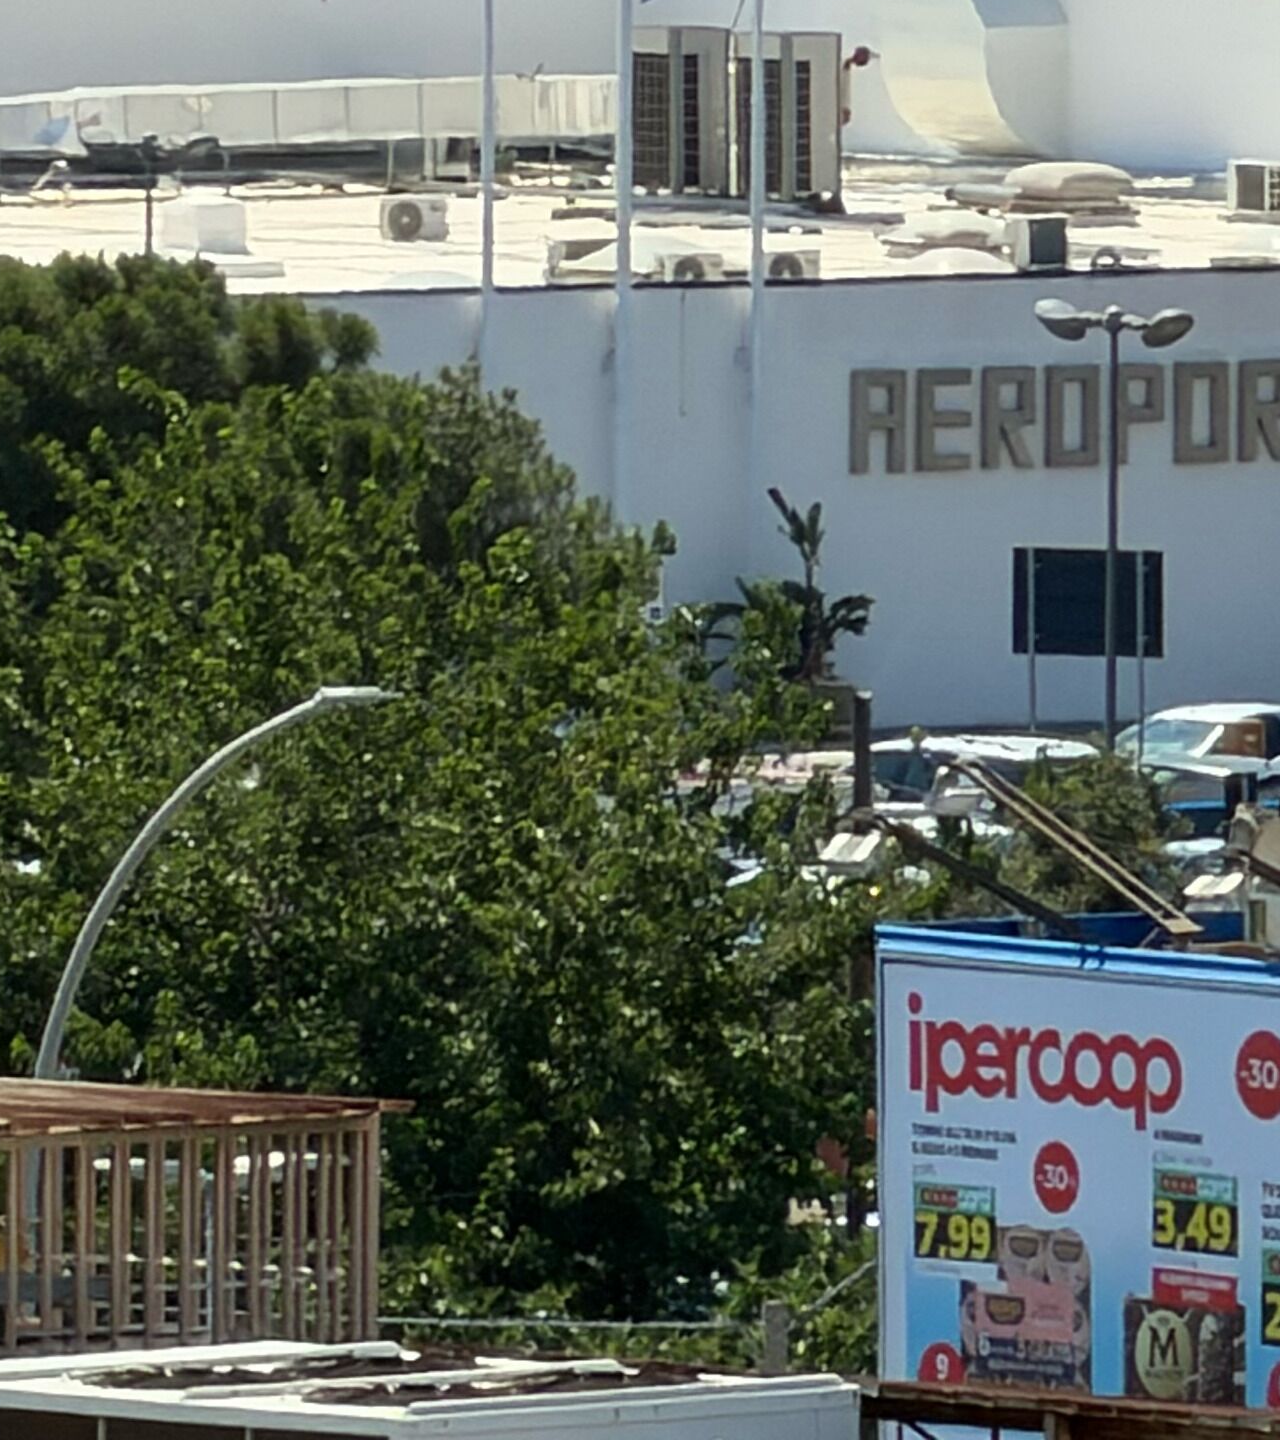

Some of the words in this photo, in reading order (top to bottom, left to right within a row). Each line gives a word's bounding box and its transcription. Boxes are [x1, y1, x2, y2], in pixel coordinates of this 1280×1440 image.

[908, 992, 1182, 1130] ipercoop
[1154, 1199, 1232, 1252] 3,49
[936, 1353, 949, 1380] 9
[1149, 1326, 1180, 1368] M
